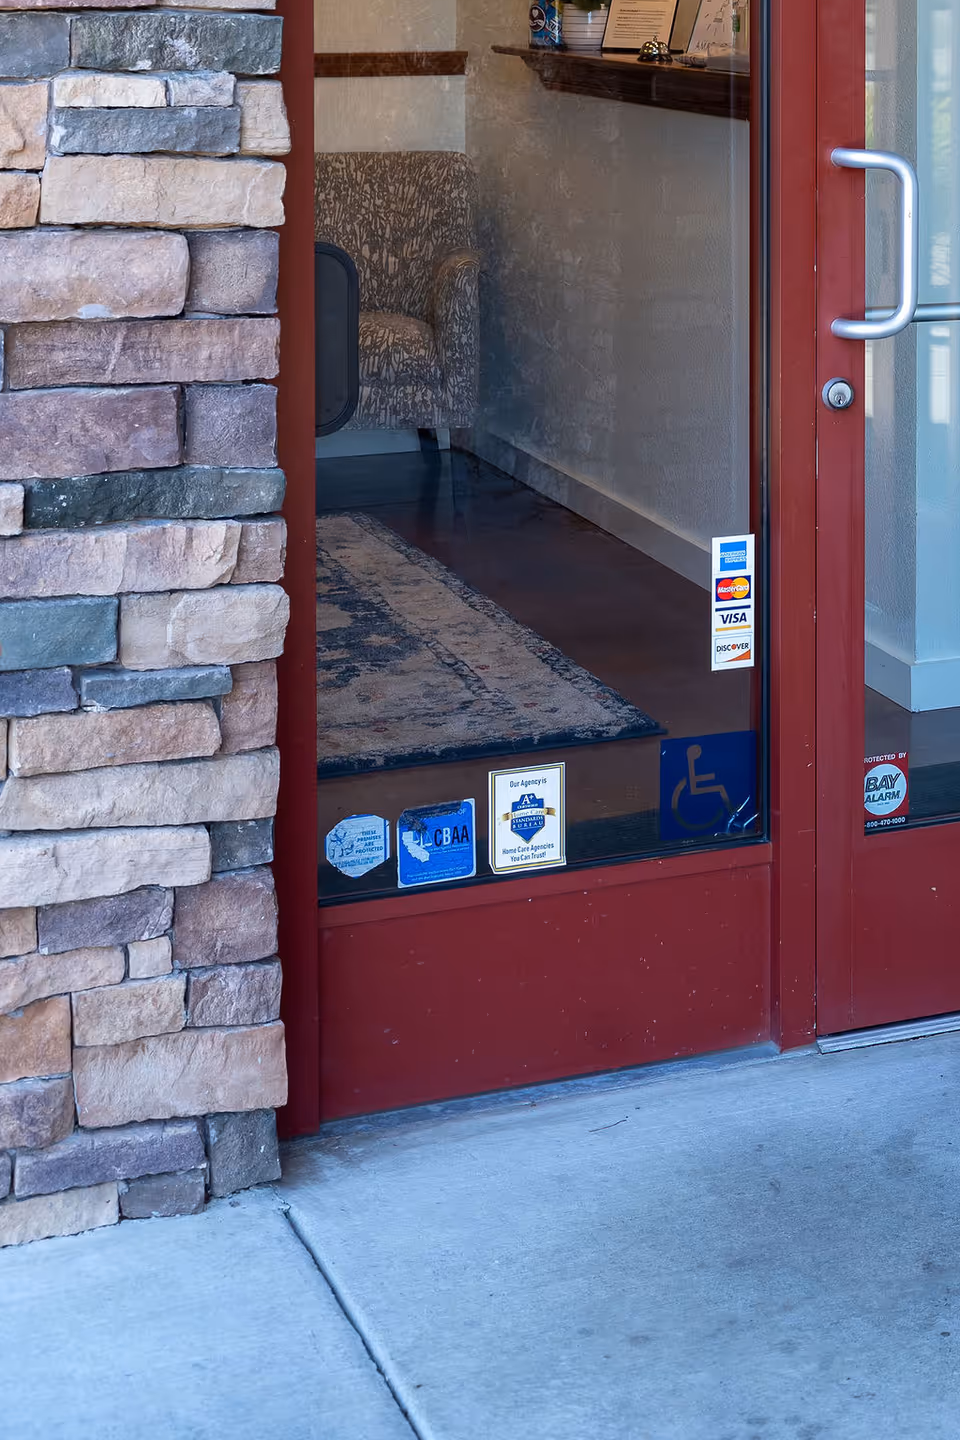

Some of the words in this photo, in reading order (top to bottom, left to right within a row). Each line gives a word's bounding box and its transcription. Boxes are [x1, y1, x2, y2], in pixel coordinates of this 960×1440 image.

[717, 583, 749, 594] MasterCard
[719, 612, 747, 625] VISA
[716, 642, 749, 653] DISCOVER
[864, 753, 896, 763] ROTECTED
[509, 779, 520, 788] Our
[520, 777, 542, 789] Agency
[541, 776, 547, 784] is
[865, 772, 901, 793] BAY
[864, 789, 901, 804] ALARM
[434, 824, 469, 847] CBAA
[355, 846, 383, 854] PROTECTED
[502, 847, 517, 855] Home
[517, 845, 530, 854] Care
[530, 842, 555, 853] Agencies
[510, 854, 520, 863] You
[520, 853, 531, 861] Can
